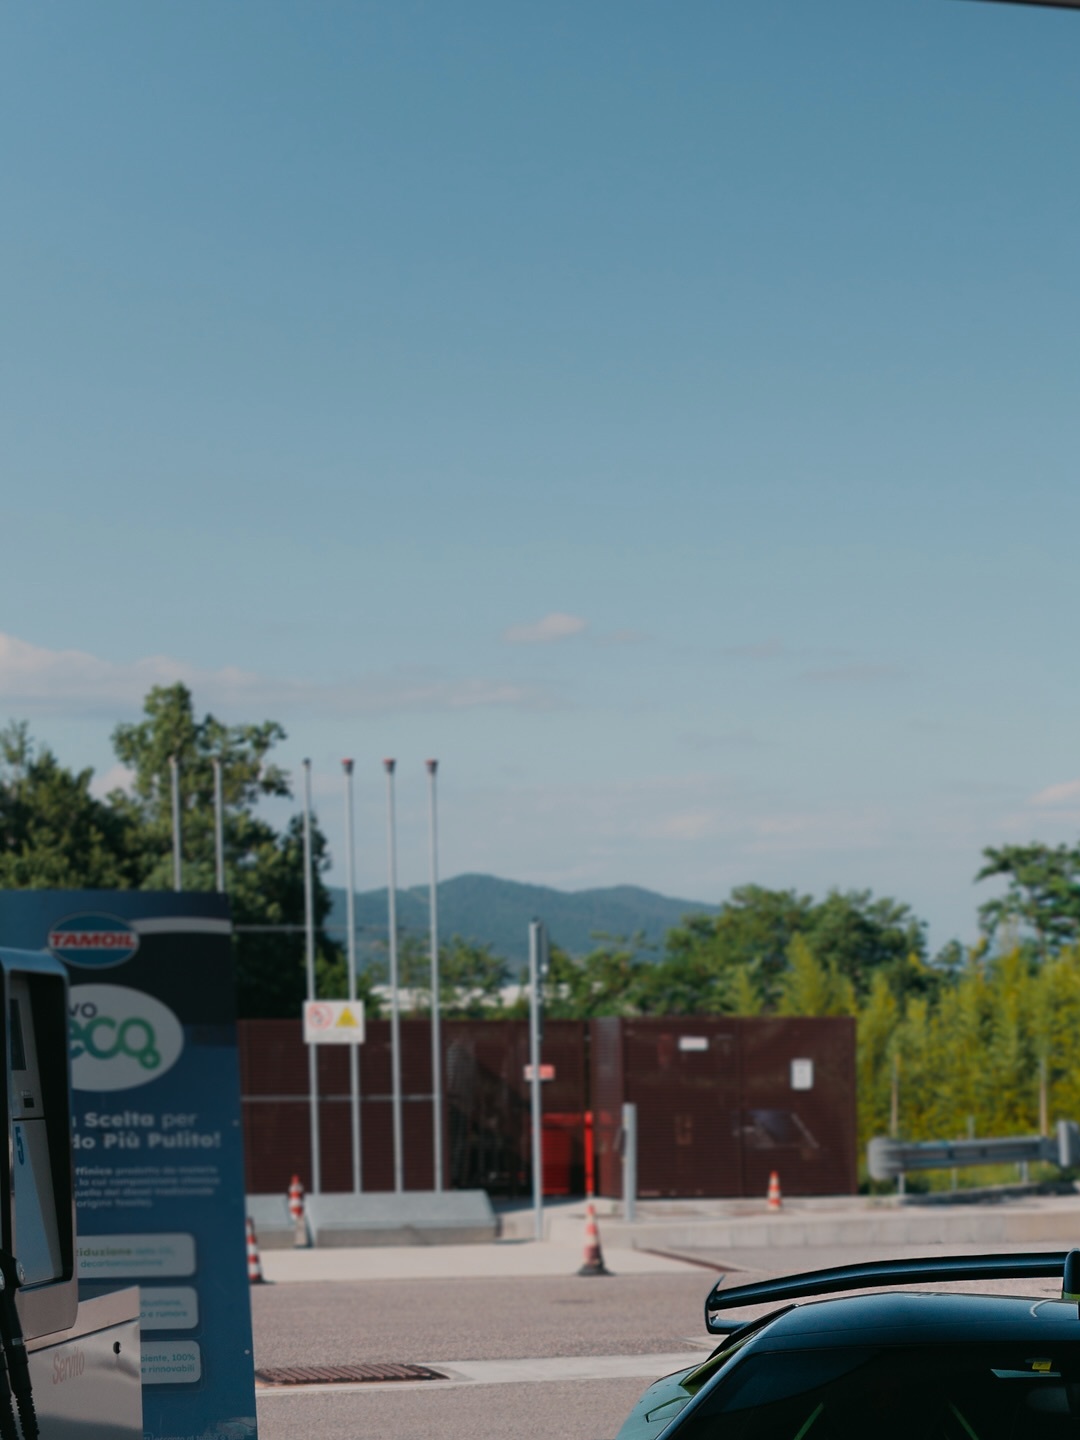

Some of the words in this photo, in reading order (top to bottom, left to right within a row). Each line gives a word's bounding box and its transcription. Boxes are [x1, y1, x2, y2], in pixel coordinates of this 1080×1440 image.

[52, 933, 135, 948] TAMOIL
[84, 1110, 155, 1128] Scelta
[161, 1112, 198, 1131] per
[15, 1126, 24, 1165] 5
[103, 1130, 140, 1149] Più
[148, 1130, 221, 1148] Pulito!
[53, 1346, 85, 1385] Servito
[173, 1353, 196, 1361] 100%
[149, 1364, 195, 1373] rinnovabili
